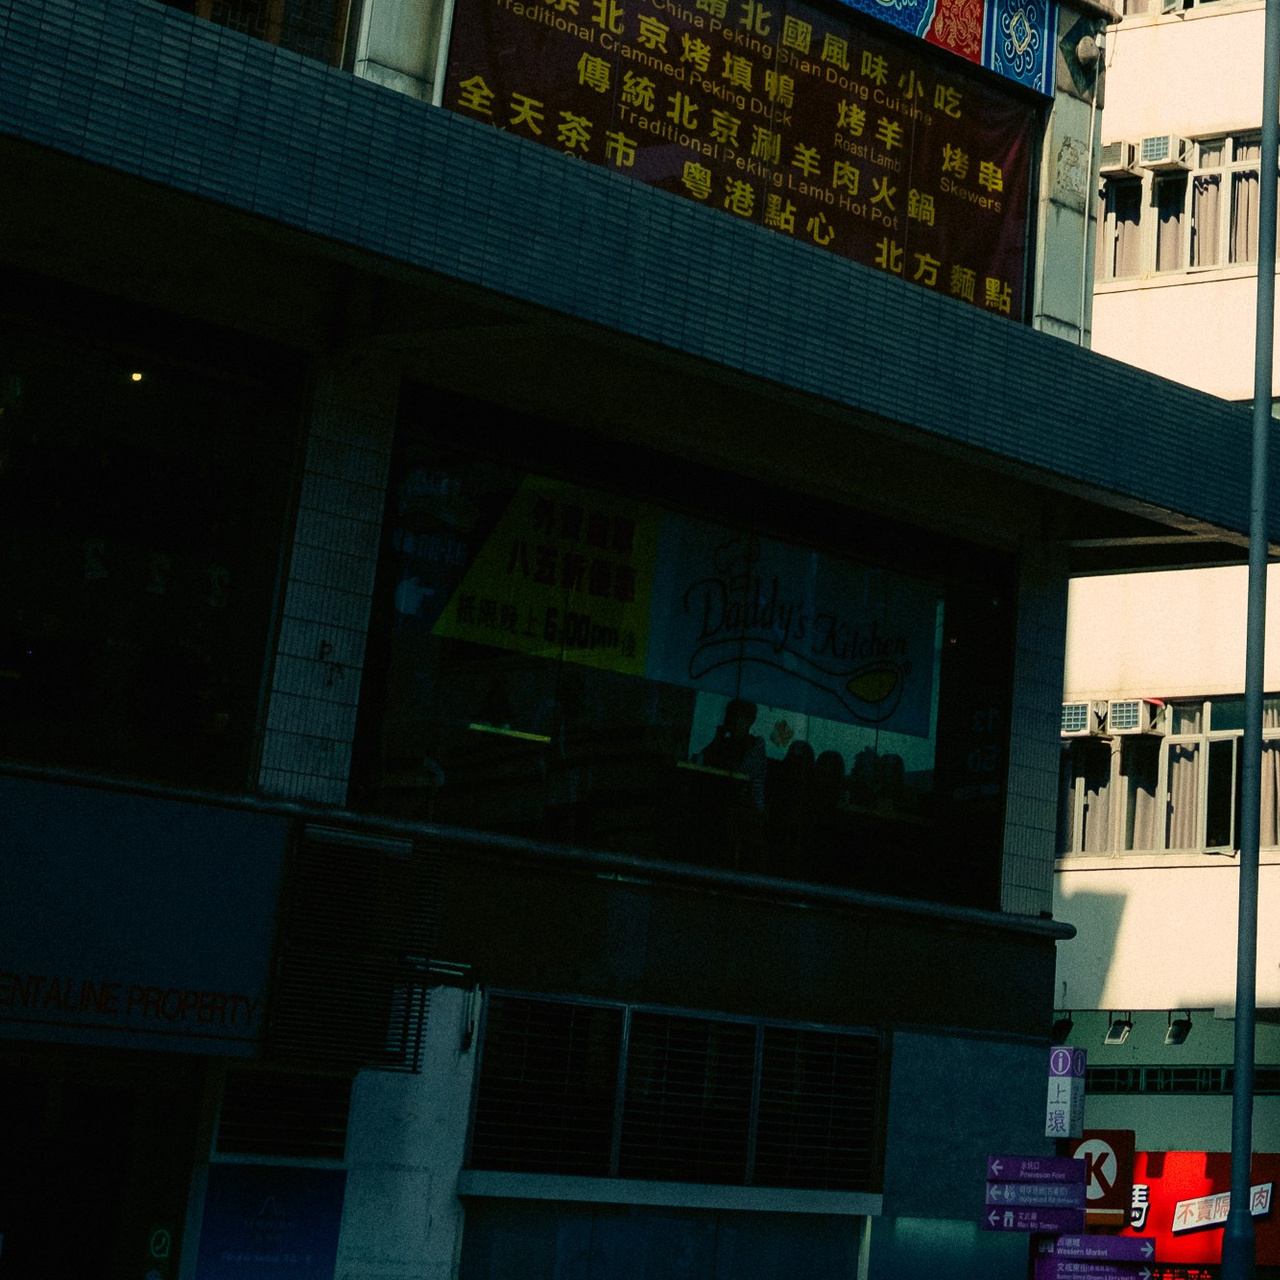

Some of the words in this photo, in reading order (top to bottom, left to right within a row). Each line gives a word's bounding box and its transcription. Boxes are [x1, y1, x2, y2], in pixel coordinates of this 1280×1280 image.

[600, 33, 685, 81] Crammed
[690, 71, 745, 110] Peking
[751, 98, 792, 127] Duck
[710, 21, 772, 60] Peking
[777, 48, 821, 75] Shan
[827, 69, 869, 101] Dong
[874, 90, 932, 127] Cuisine
[457, 75, 637, 168] 全天茶市
[836, 99, 904, 151] 烤羊
[617, 103, 717, 159] Traditional
[722, 149, 783, 189] Peking
[788, 171, 834, 205] Lamb
[839, 194, 867, 216] Hot
[871, 206, 899, 230] Pot
[834, 133, 869, 161] Roast
[871, 147, 901, 172] Lamb
[941, 143, 1004, 193] 烤串
[681, 160, 835, 246] 粵港點心
[940, 177, 1002, 213] Skewers
[126, 983, 260, 1028] PROPERTY
[1048, 1082, 1067, 1133] 上環
[1177, 1187, 1269, 1226] 不賣隔肉
